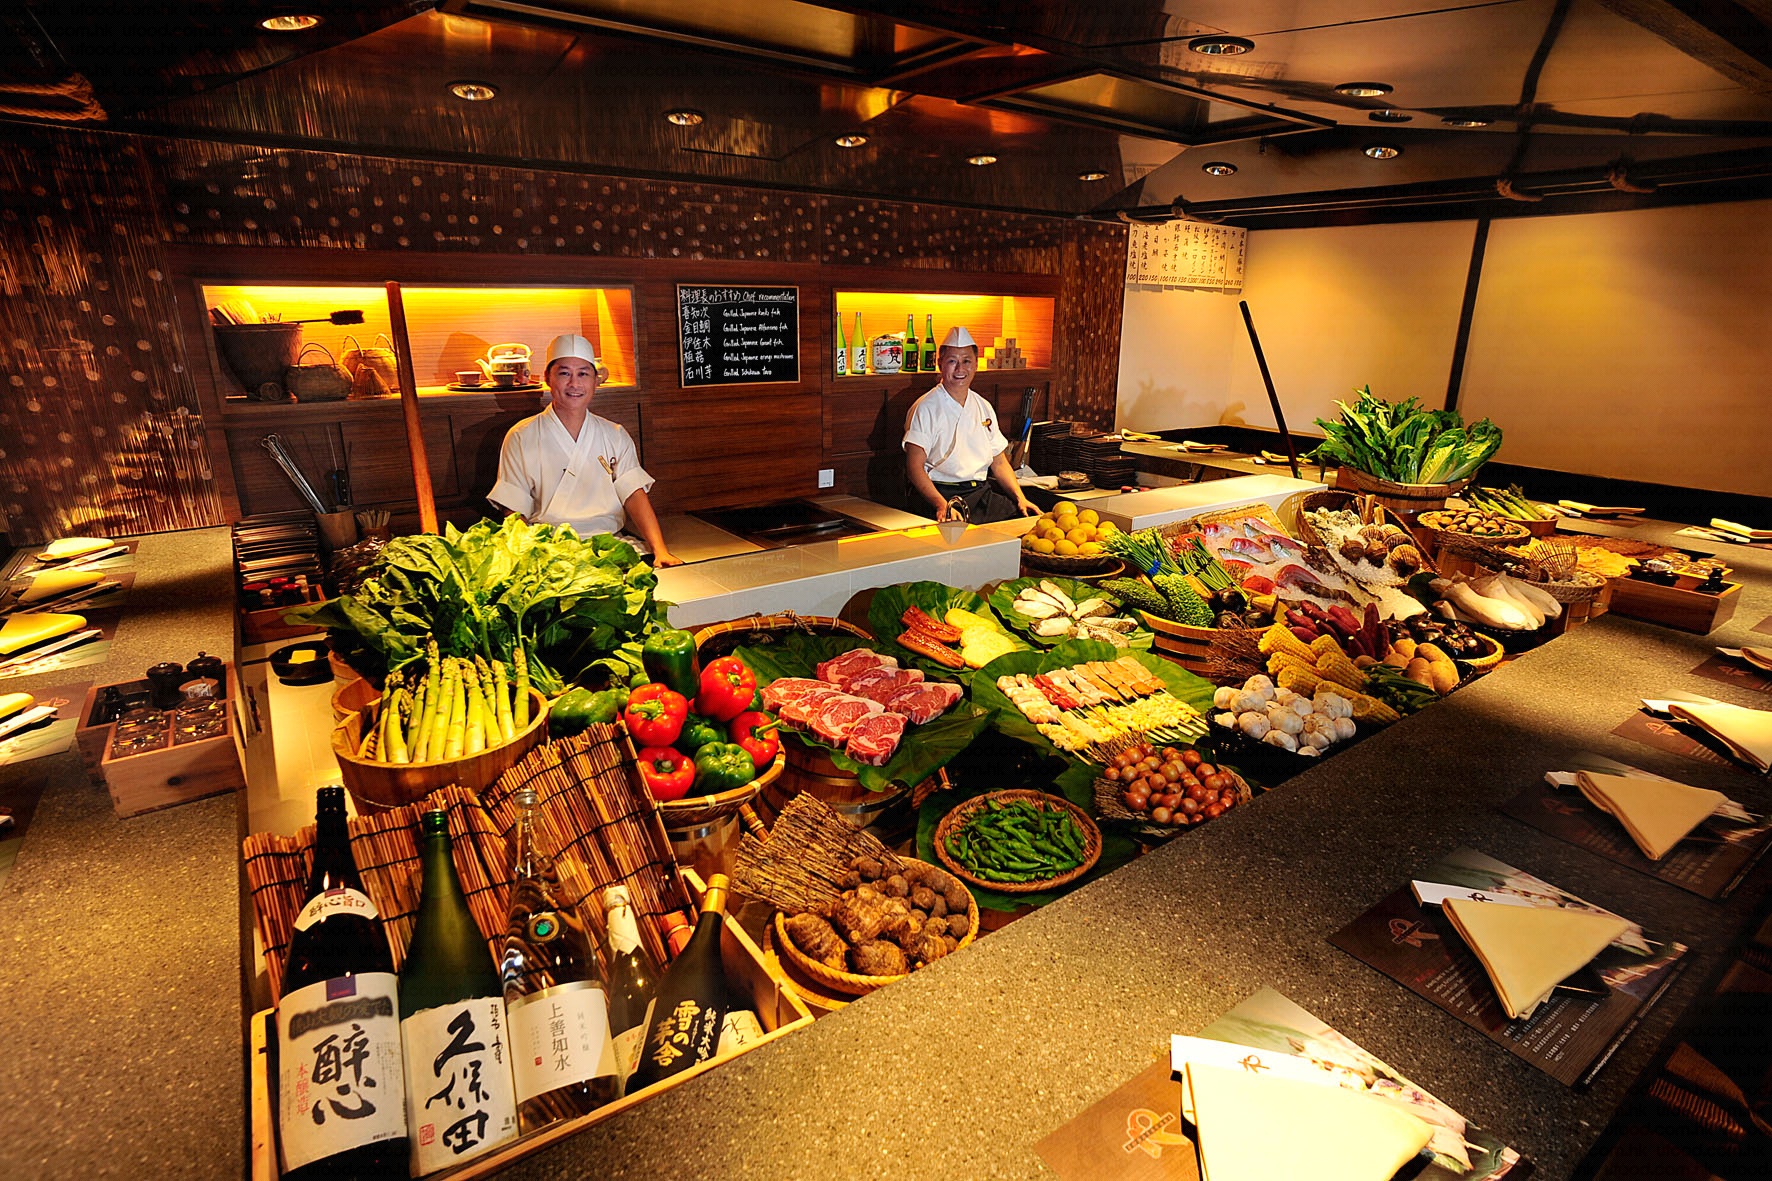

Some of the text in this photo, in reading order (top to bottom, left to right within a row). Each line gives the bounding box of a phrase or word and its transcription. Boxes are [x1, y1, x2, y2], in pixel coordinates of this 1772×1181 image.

[680, 289, 740, 303] 料理長のおすすめ
[683, 320, 711, 334] 金目鯛
[683, 336, 711, 349] 伊佐木
[888, 347, 901, 364] 梵
[685, 364, 712, 379] 石川芋
[548, 1003, 571, 1071] 上善如水
[425, 1009, 490, 1154] 久保田
